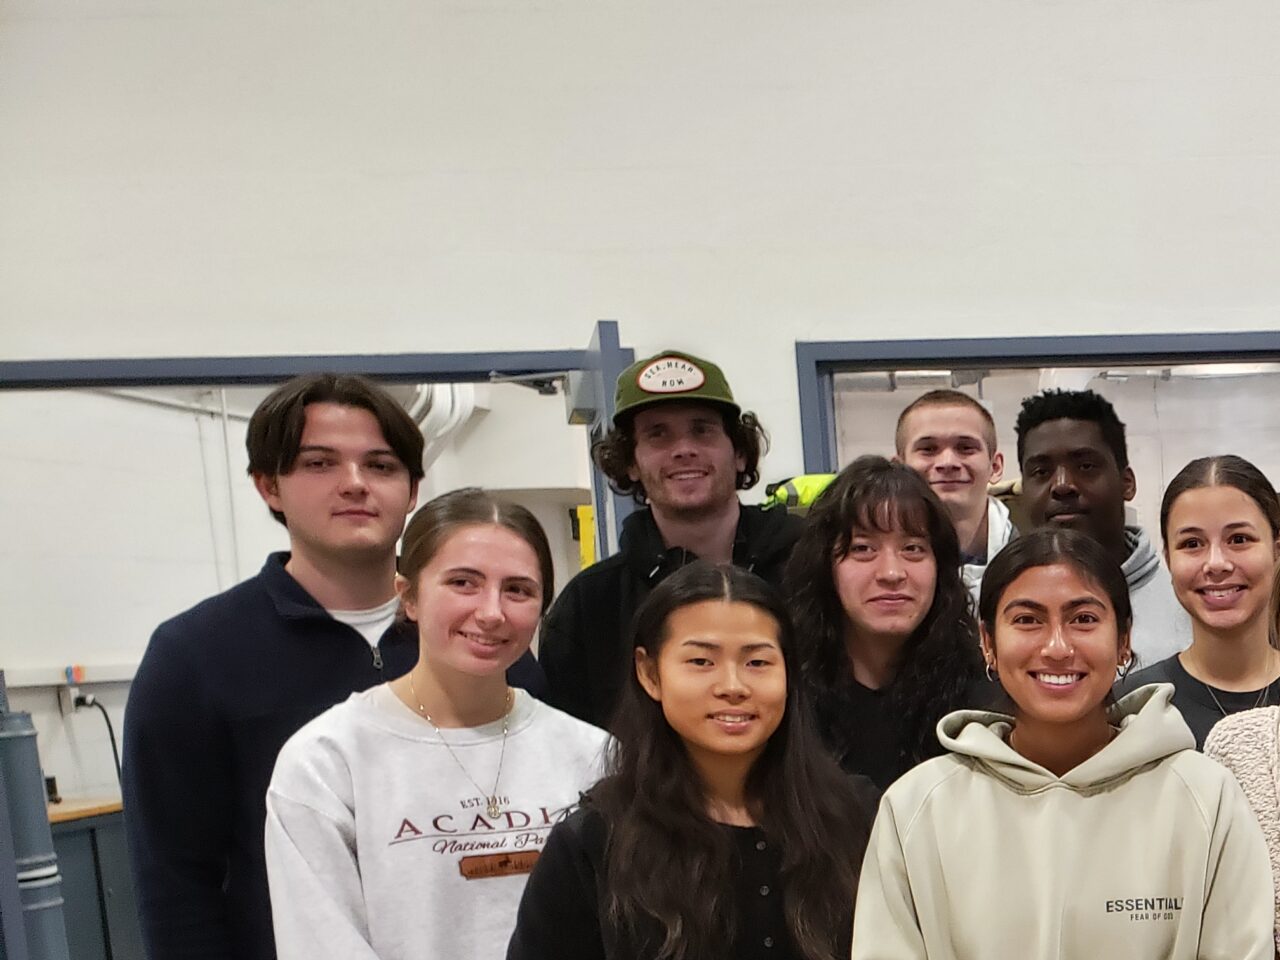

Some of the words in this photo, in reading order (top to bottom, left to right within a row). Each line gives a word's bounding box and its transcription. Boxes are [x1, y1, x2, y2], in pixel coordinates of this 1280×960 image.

[460, 797, 484, 809] EST.
[394, 807, 553, 839] ACADI
[432, 837, 507, 855] National
[514, 833, 545, 848] Pa
[1106, 897, 1184, 913] ESSENTIAL
[1130, 912, 1149, 921] FEAR
[1152, 912, 1161, 921] OF
